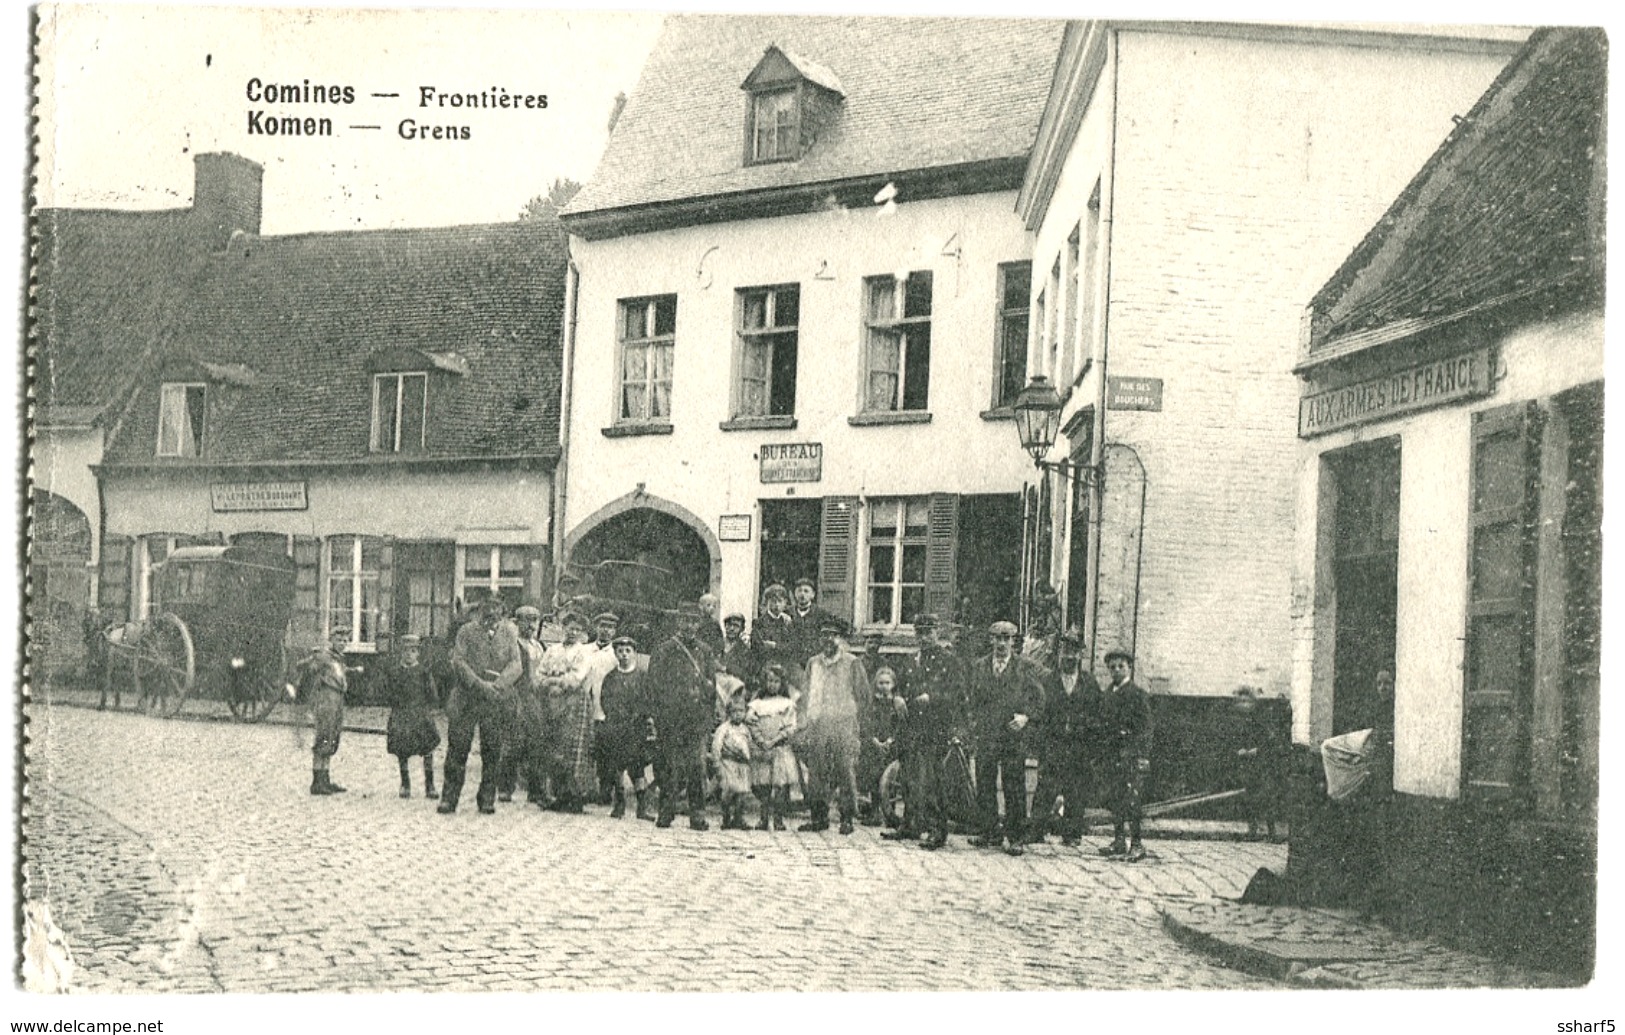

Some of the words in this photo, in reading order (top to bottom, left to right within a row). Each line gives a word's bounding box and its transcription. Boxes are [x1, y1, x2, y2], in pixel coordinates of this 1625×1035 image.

[1120, 381, 1135, 391] RUE
[1136, 382, 1151, 392] DES
[1307, 396, 1334, 427] AUX
[1336, 382, 1386, 421] ARMES
[1390, 376, 1409, 404] DE
[1412, 357, 1480, 401] FRANCE
[762, 445, 818, 460] BUREAU
